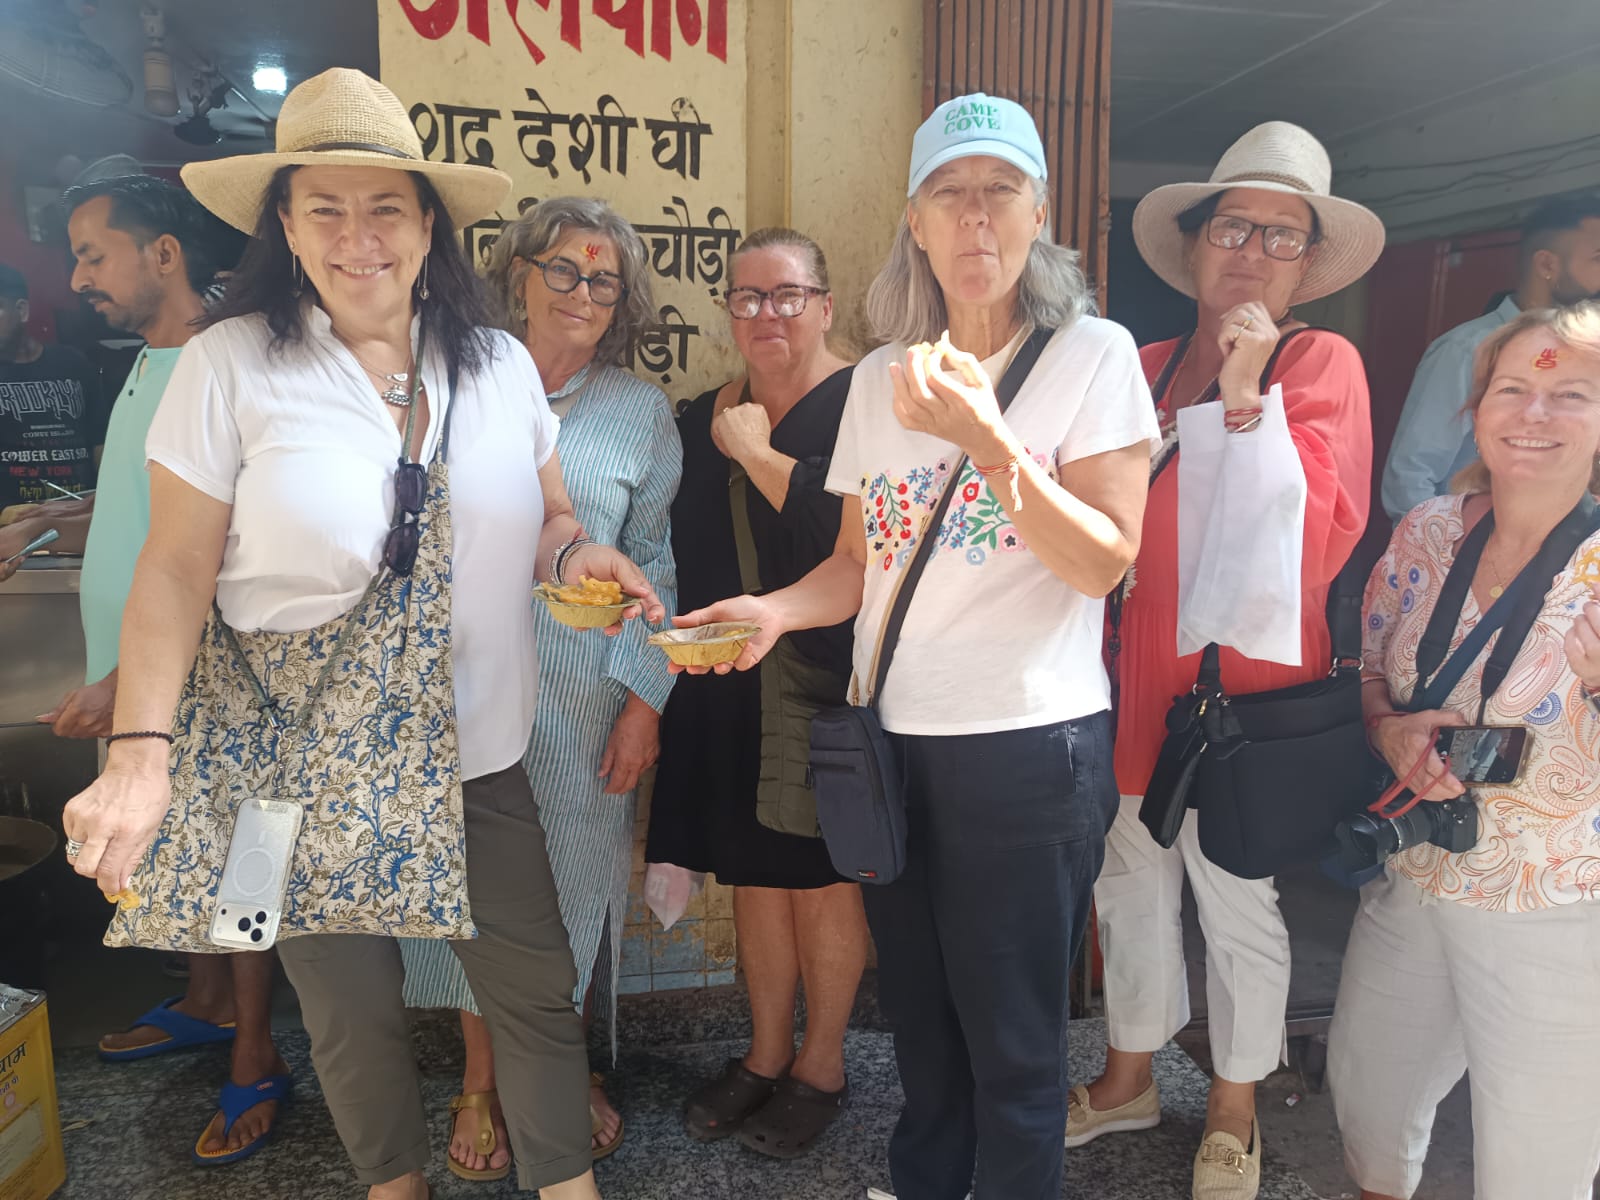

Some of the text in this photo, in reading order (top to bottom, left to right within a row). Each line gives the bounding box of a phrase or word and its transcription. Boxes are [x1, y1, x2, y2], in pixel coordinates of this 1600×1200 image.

[944, 115, 1001, 135] COVE
[1, 449, 49, 463] LOWER
[51, 447, 76, 462] EAST
